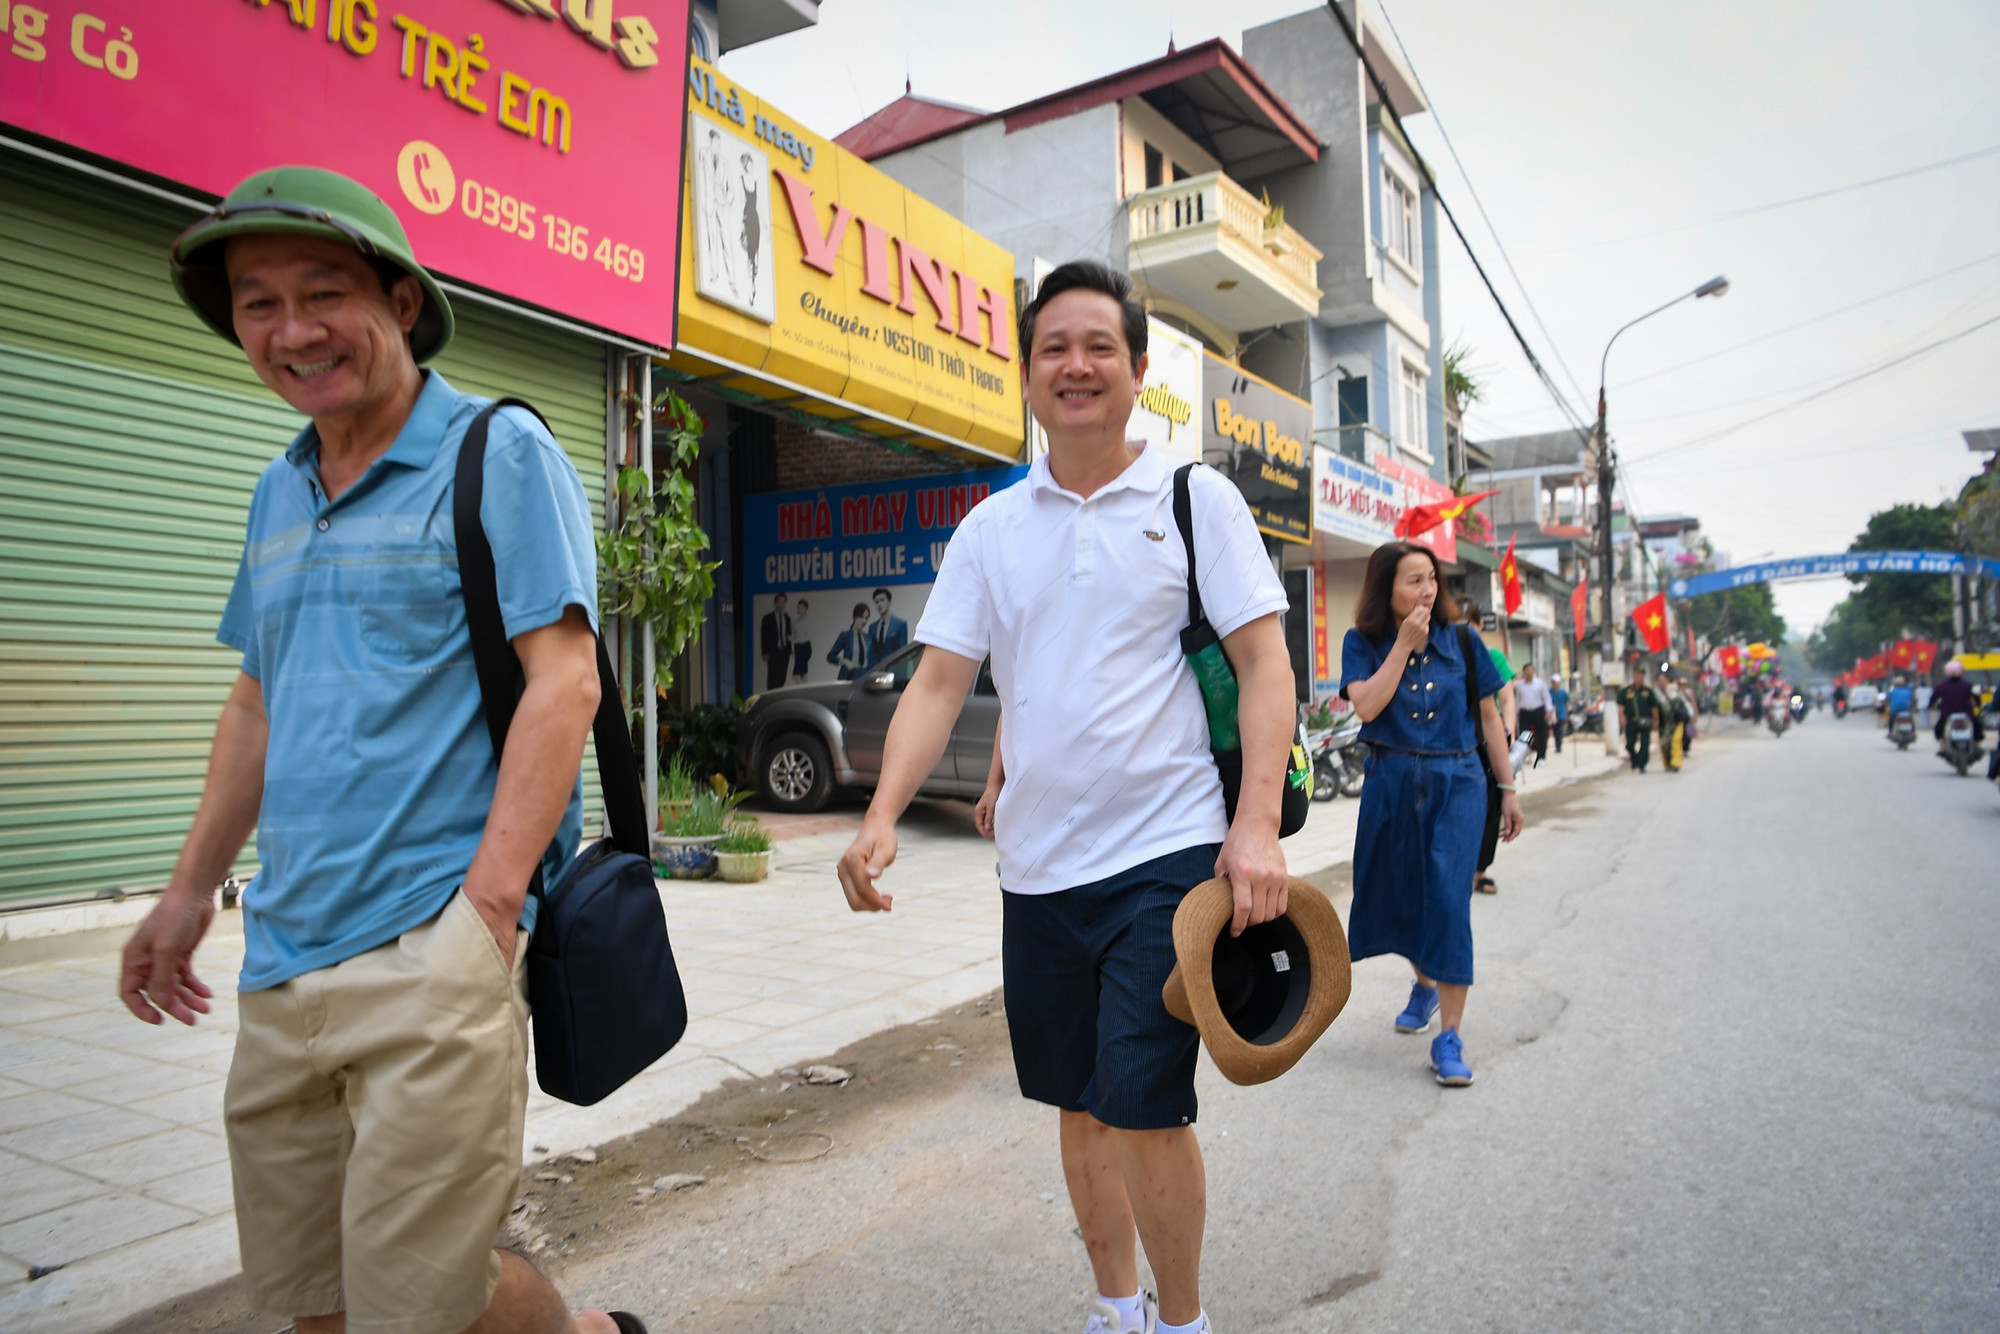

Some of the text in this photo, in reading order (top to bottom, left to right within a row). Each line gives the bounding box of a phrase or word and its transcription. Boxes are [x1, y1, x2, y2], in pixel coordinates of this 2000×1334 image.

[71, 13, 139, 80] Cỏ
[393, 13, 490, 114] TRẺ
[753, 114, 815, 172] may
[461, 179, 645, 283] 0395 136 469
[772, 168, 1012, 361] VINH
[969, 364, 1004, 395] TRANG
[1136, 383, 1192, 441] outique
[1213, 398, 1302, 467] Bon Bon
[778, 492, 832, 542] NHÀ
[842, 490, 907, 537] MAY
[765, 546, 834, 584] CHUYÊN
[840, 545, 906, 579] COMLE
